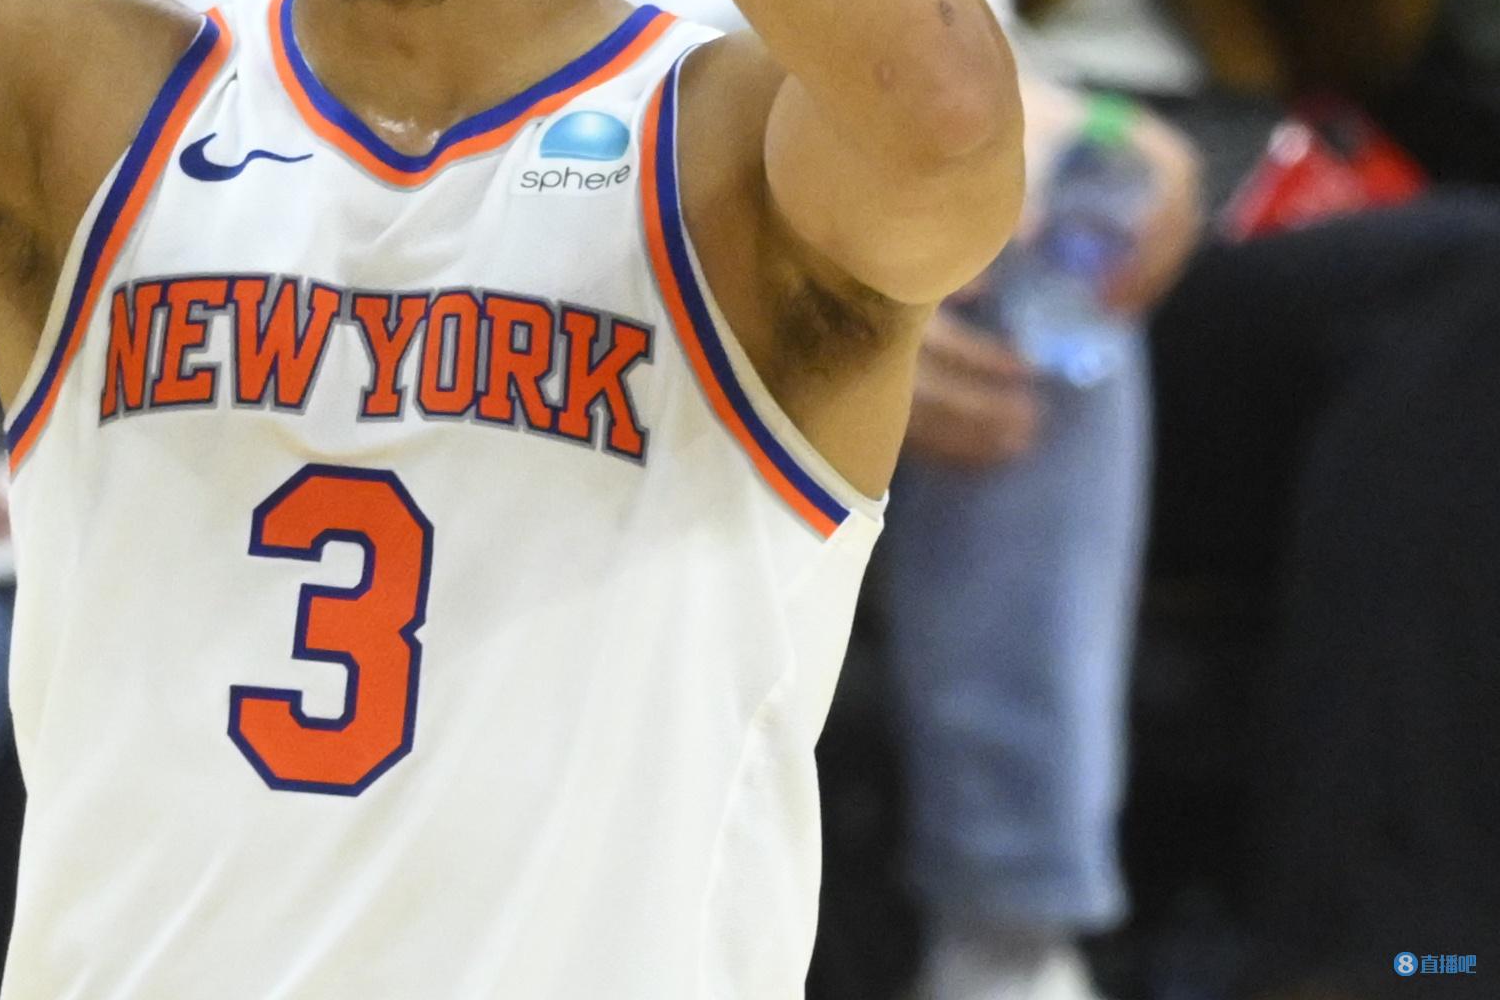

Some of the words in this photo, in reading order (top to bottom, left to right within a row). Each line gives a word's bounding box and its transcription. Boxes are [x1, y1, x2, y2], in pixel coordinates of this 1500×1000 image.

[520, 164, 631, 192] sphere
[99, 272, 344, 428] NEW
[348, 286, 655, 466] YORK
[227, 463, 434, 797] 3
